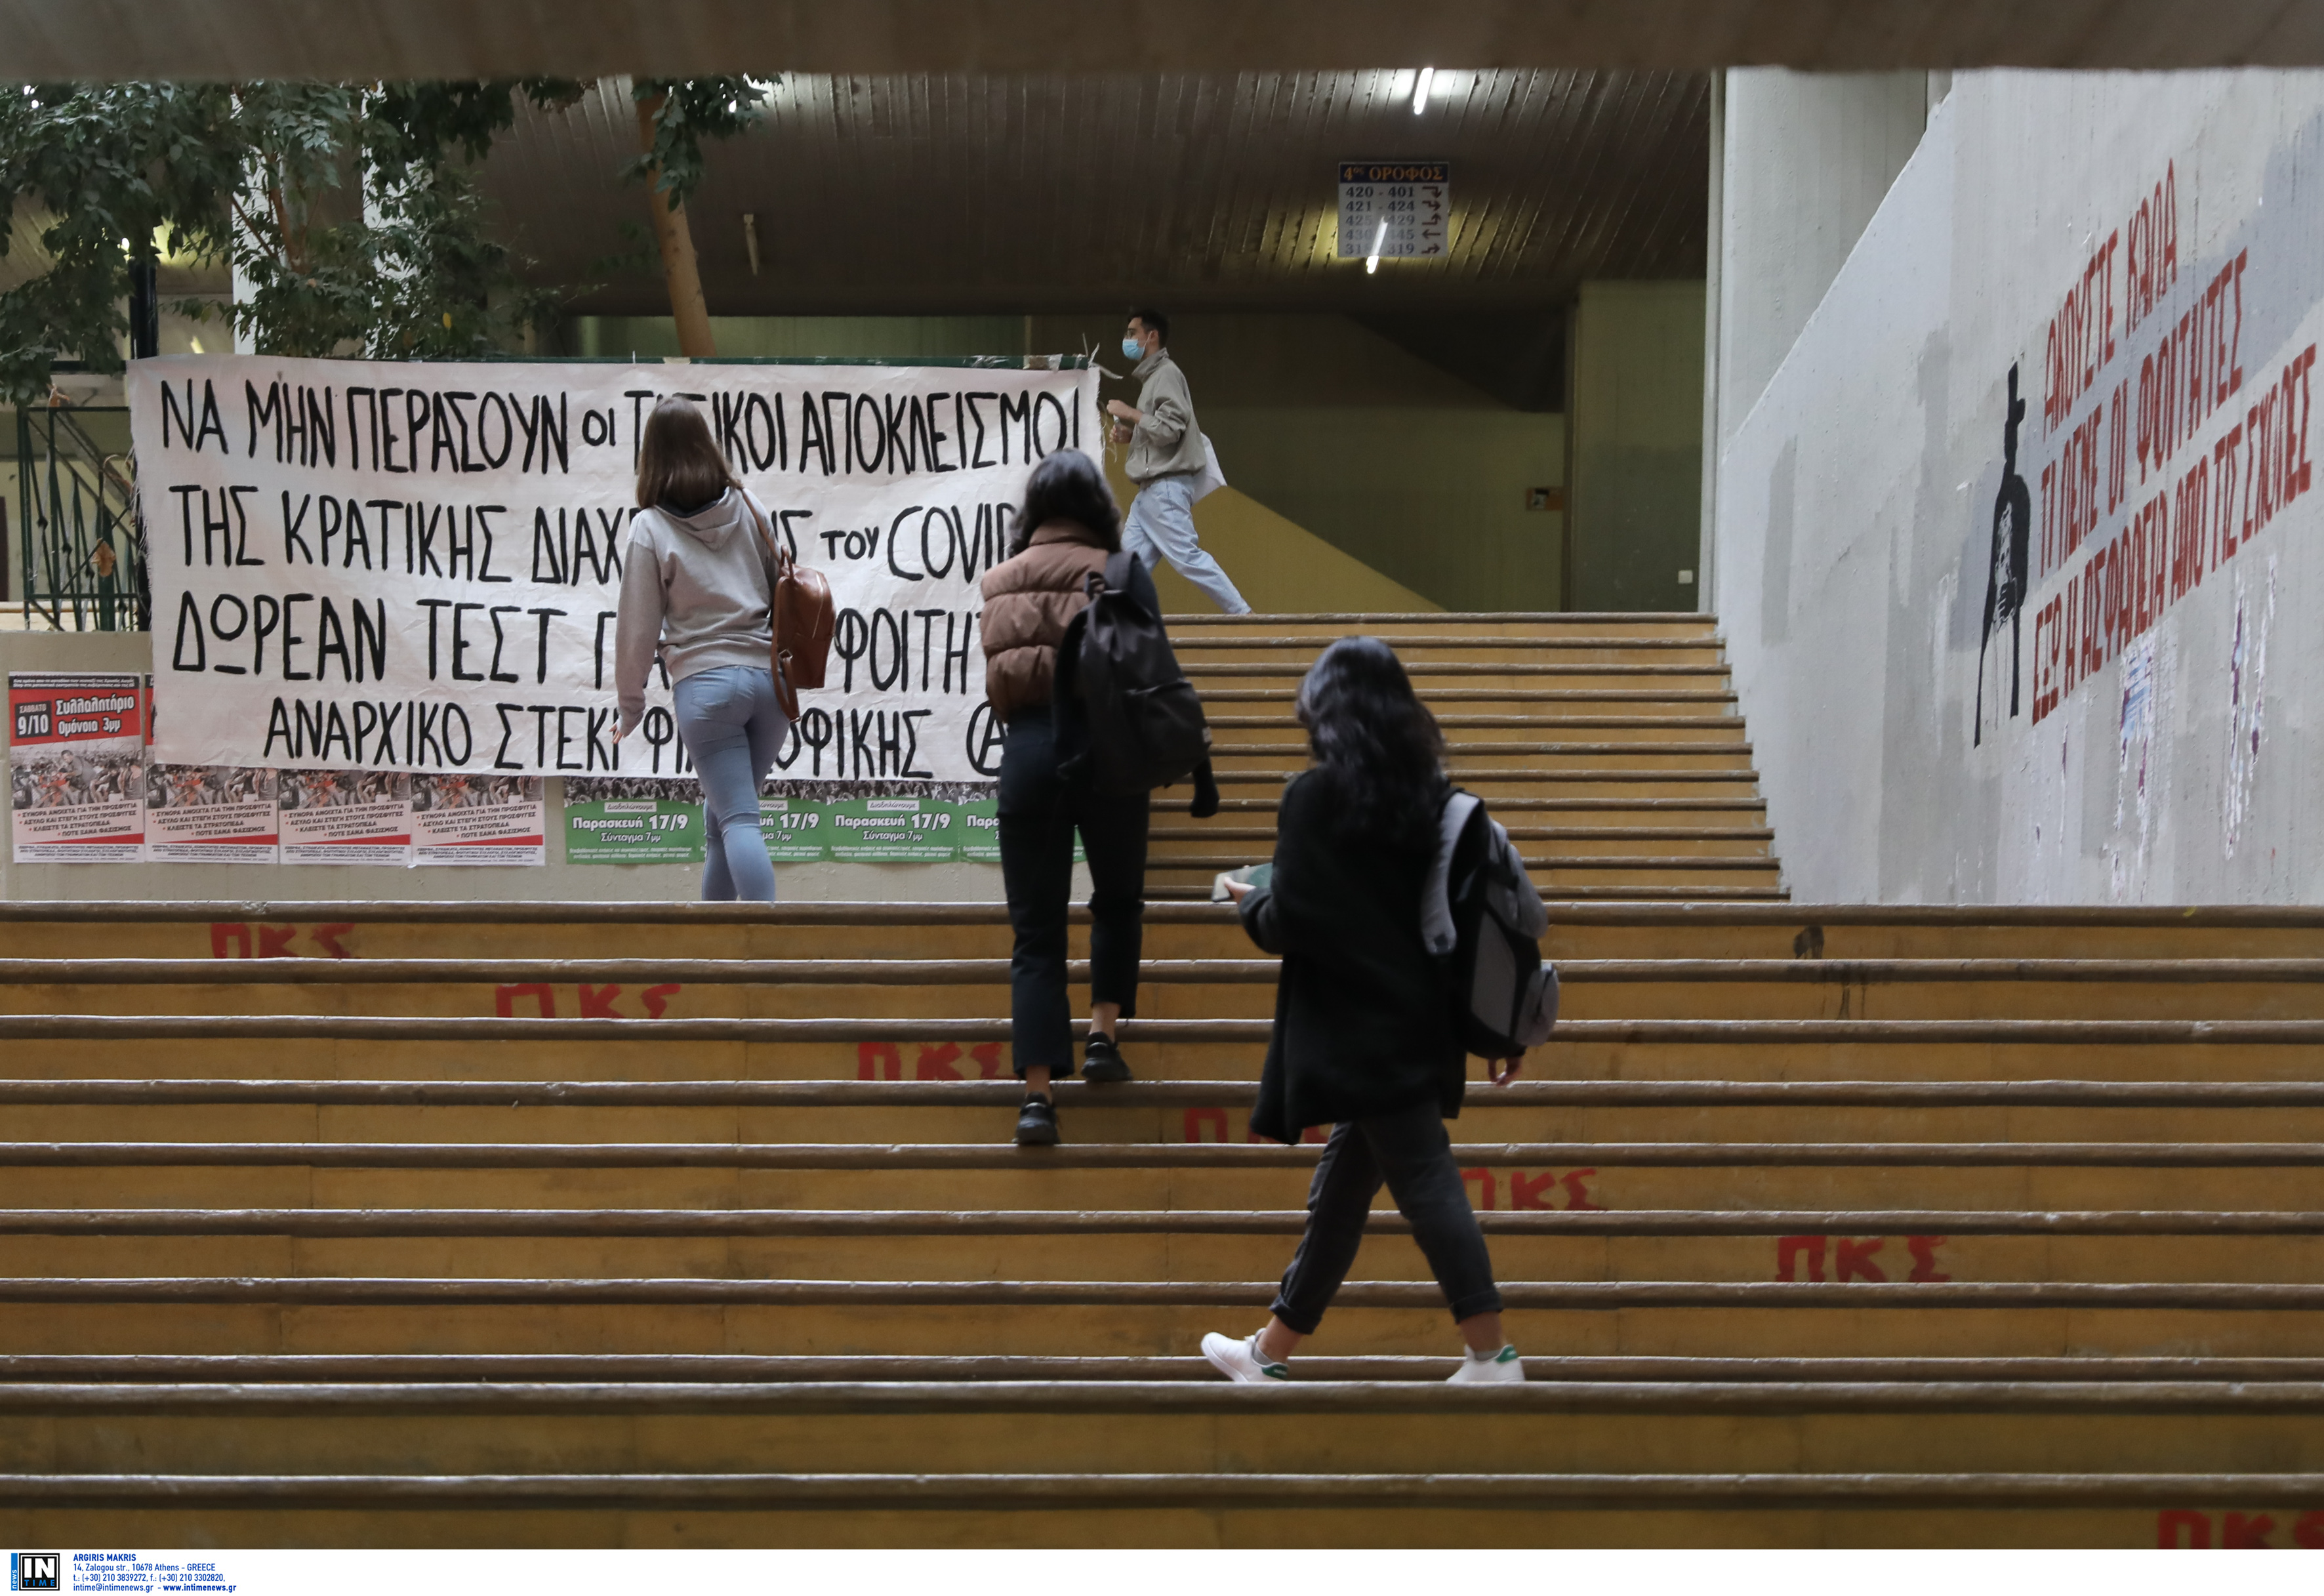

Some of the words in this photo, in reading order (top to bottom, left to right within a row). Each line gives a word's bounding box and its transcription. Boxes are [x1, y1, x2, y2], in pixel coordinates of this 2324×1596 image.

[1369, 167, 1443, 180] ΟΡΟΦΟΣ
[1346, 186, 1374, 197] 420
[1388, 186, 1414, 197] 401
[1346, 201, 1371, 212] 421
[1388, 201, 1415, 212] 424
[2044, 228, 2117, 443] ΑΚΟΥΣΤΕ
[2126, 157, 2176, 340] ΚΑΛΑ
[2040, 460, 2056, 577] ΤΙ
[2060, 403, 2102, 569] ΛΕΝΕ
[2108, 379, 2128, 516] ΟΙ
[2136, 246, 2247, 485] ΦΟΙΤΗΤΕΣ
[161, 379, 229, 454] ΝΑ
[246, 379, 335, 468] ΜΗΝ
[346, 387, 569, 474] ΠΕΡΑΣΟΥΝ
[624, 390, 786, 474] ΤΙΚΟΙ
[800, 387, 1081, 476] ΑΠΟΚΛΕΙΣΜΟΙ
[169, 485, 264, 567] ΤΗΣ
[282, 490, 512, 583] ΚΡΑΤΙΚΗΣ
[2033, 592, 2062, 726] ΕΞΩ
[2064, 575, 2078, 698] Η
[2081, 490, 2167, 682] ΑΣΦΑΛΕΙΑ
[2170, 455, 2208, 606] ΑΠΟ
[2211, 422, 2244, 573] ΤΙΣ
[2242, 343, 2316, 544] ΣΧΟΛΕΣ
[173, 590, 386, 684] ΔΩΡΕΑΝ
[417, 598, 567, 685] ΤΕΣΤ
[835, 607, 983, 695] ΦΟΙΤΗ
[18, 714, 49, 735] 9/10
[102, 717, 121, 734] 3μμ
[264, 697, 472, 766] ΑΝΑΡΧΙΚΟ
[495, 703, 619, 771] ΣΤΕΚΙ
[573, 815, 643, 831] Παρασκευή
[649, 814, 689, 831] 17/9
[780, 813, 820, 830] 17/9
[835, 814, 906, 830] Παρασκευή
[911, 813, 951, 830] 17/9
[601, 832, 643, 844] Σύνταγμα
[645, 832, 661, 843] 7μμ
[776, 830, 792, 842] 7μμ
[863, 830, 906, 842] Σύνταγμα
[907, 830, 923, 842] 7μμ
[1775, 1235, 1951, 1282] ΠΚΣ
